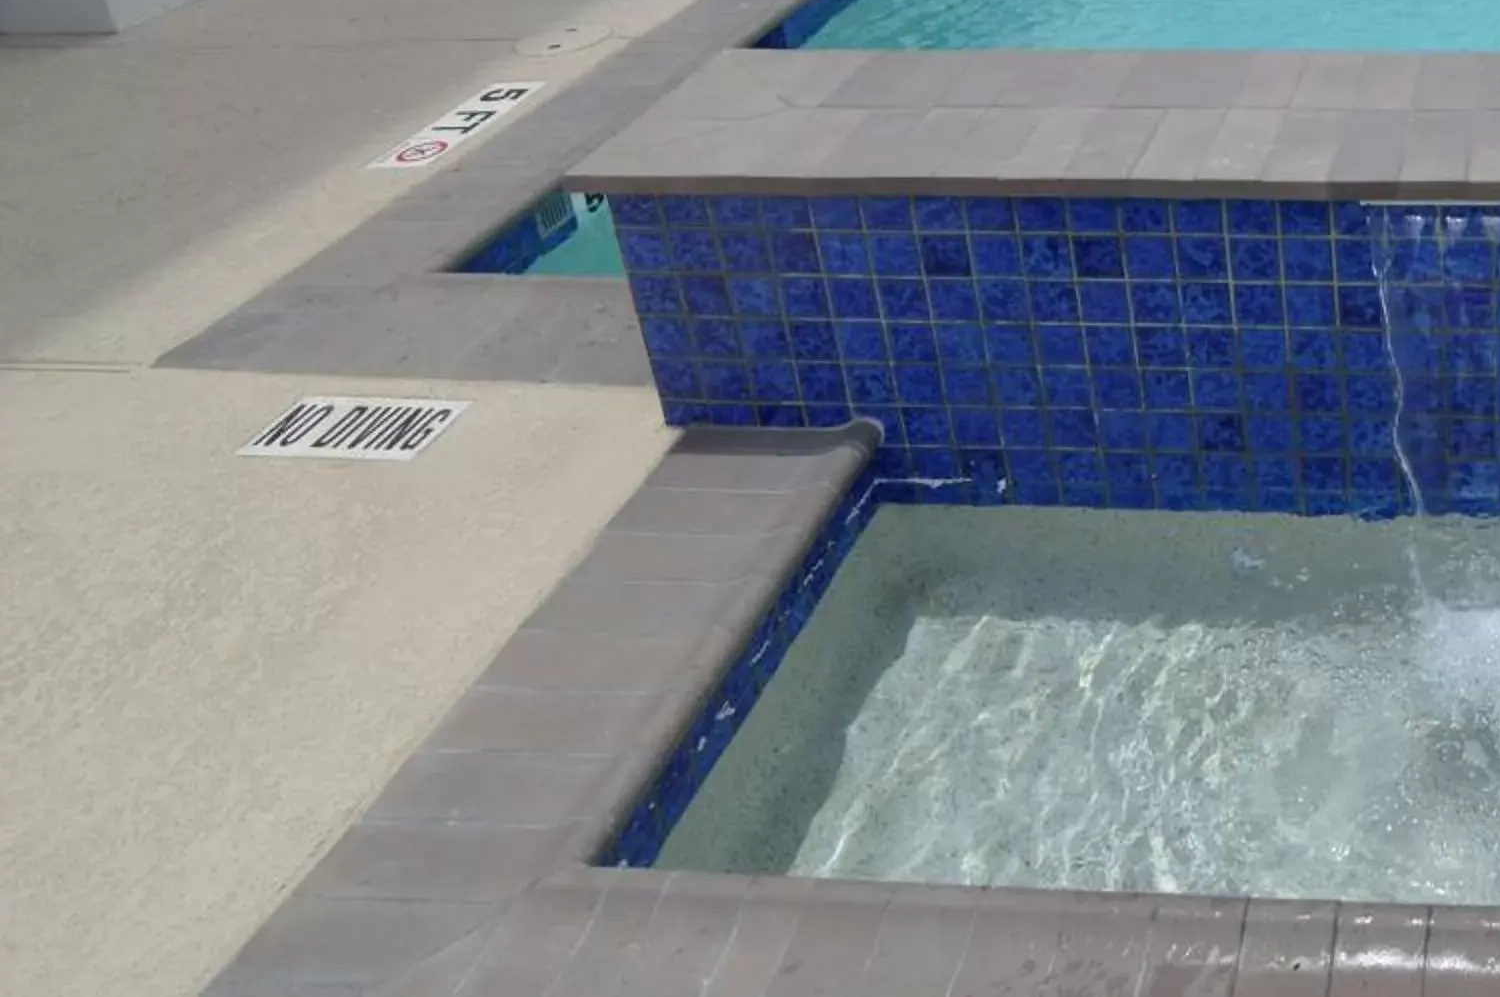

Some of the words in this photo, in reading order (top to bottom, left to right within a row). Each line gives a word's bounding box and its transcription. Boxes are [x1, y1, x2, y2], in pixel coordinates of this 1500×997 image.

[479, 87, 529, 102] 5
[431, 109, 496, 134] FT
[251, 404, 335, 447] NO
[309, 406, 453, 450] DIVING
